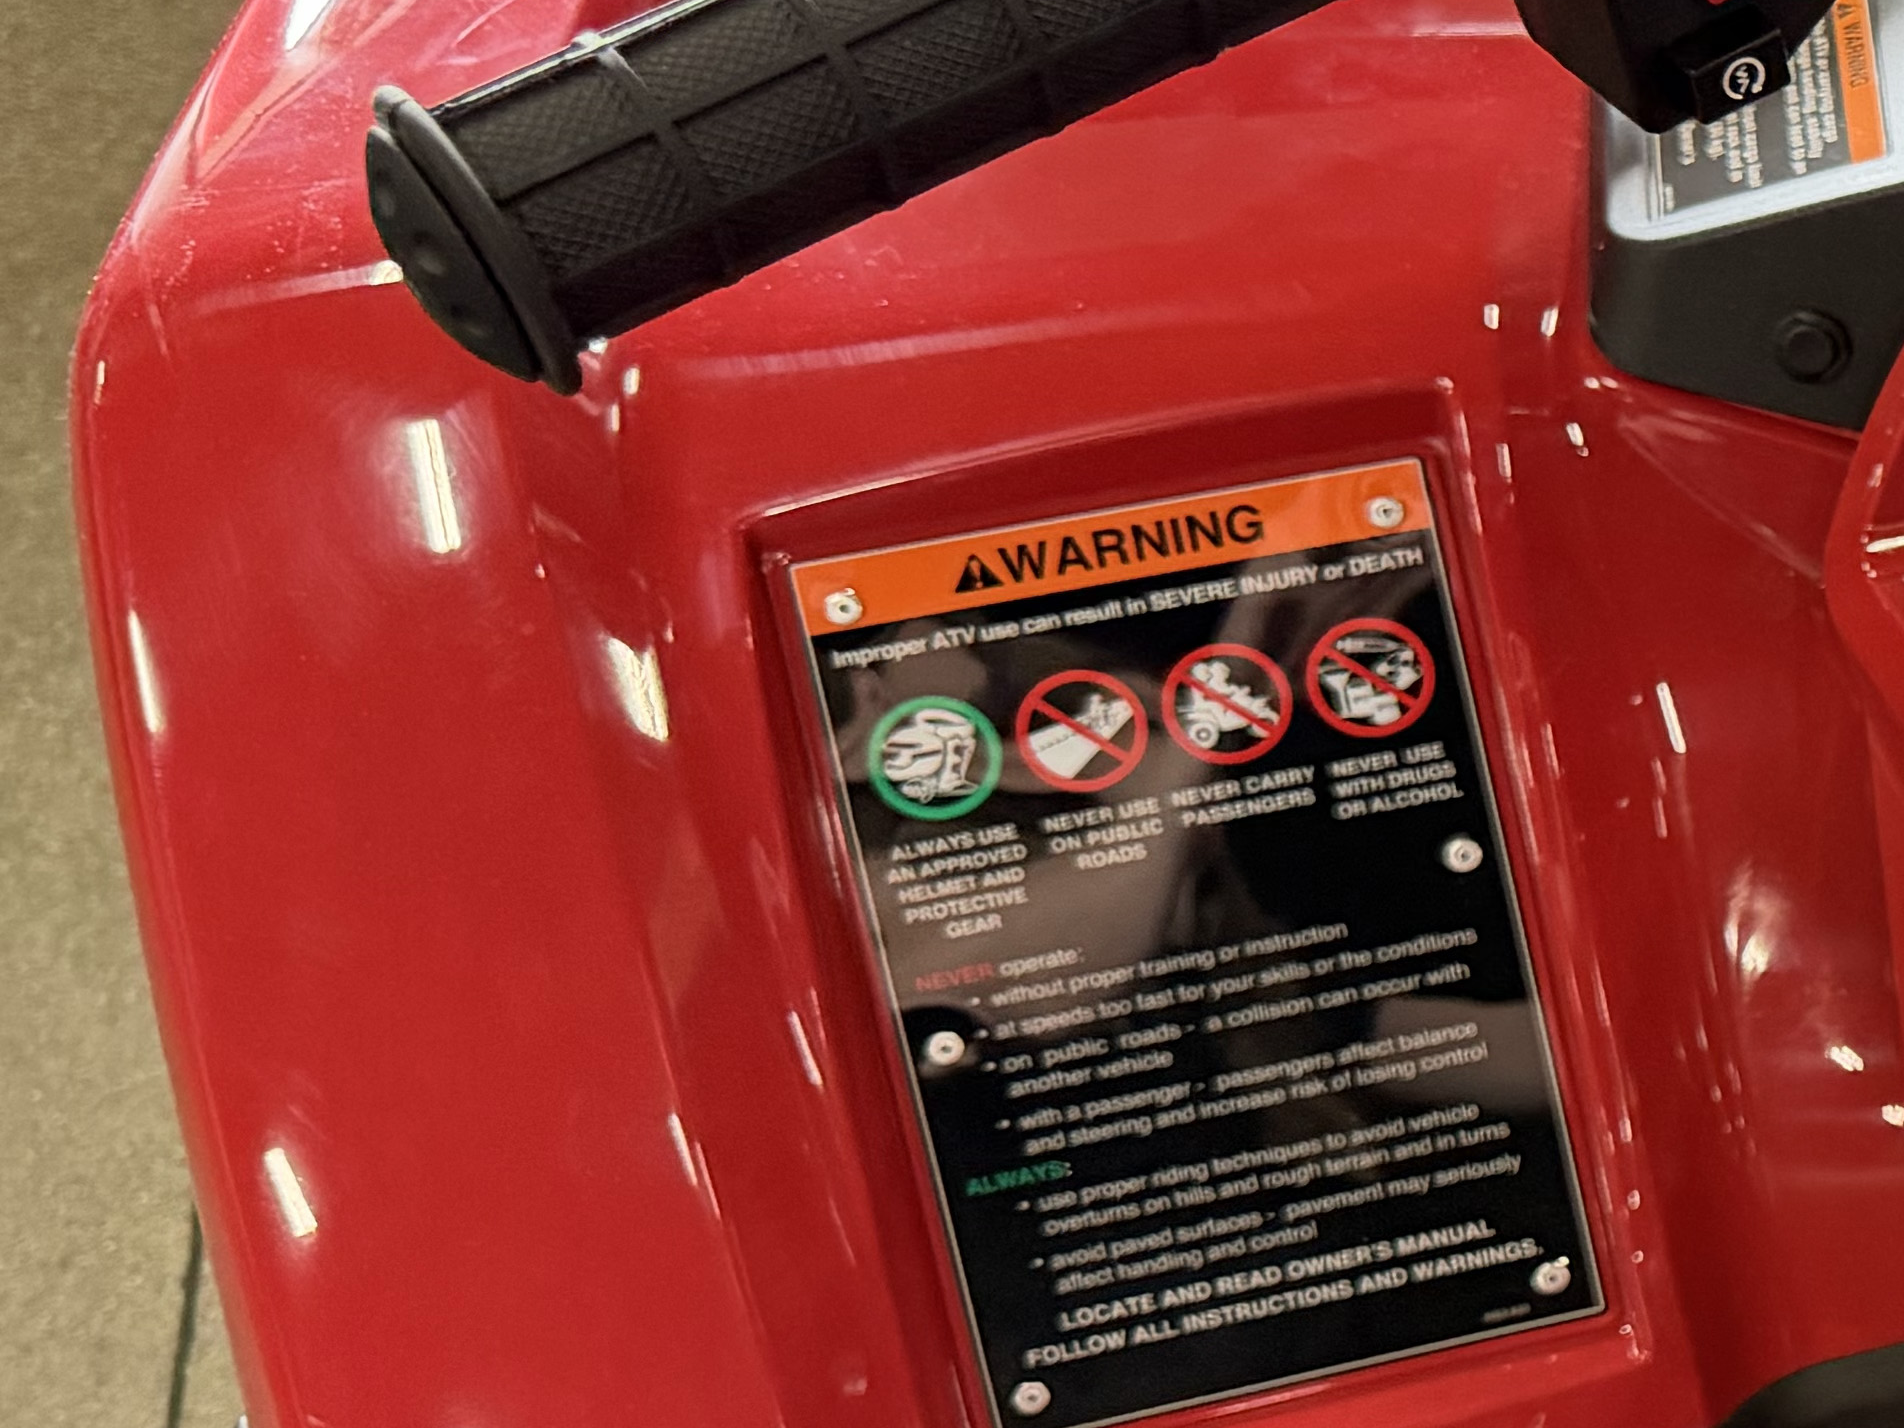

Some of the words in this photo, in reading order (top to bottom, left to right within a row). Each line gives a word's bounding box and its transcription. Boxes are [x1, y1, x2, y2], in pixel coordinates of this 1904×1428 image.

[1844, 22, 1867, 88] WARNING
[998, 503, 1267, 585] WARNING
[830, 633, 930, 672] Improper
[929, 625, 977, 650] ATV
[979, 621, 1020, 642] use
[1021, 614, 1061, 634] can
[1062, 599, 1124, 626] result
[1124, 595, 1147, 615] in
[1148, 578, 1240, 611] SEVERE
[1240, 564, 1320, 595] INJURY
[1323, 562, 1346, 580] or
[1348, 545, 1425, 576] DEATH
[1330, 749, 1398, 778] NEVER
[1403, 740, 1446, 764] USE
[1335, 774, 1387, 799] WITH
[1387, 760, 1456, 789] DRUGS
[1170, 779, 1242, 809] NEVER
[1244, 764, 1317, 795] CARRY
[1181, 786, 1317, 828] PASSENGERS
[1334, 797, 1368, 820] OR
[1368, 779, 1464, 813] ALCOHOL
[1042, 805, 1115, 834] NEVER
[1117, 796, 1161, 820] USE
[1049, 832, 1082, 854] ON
[1085, 817, 1165, 847] PUBLIC
[885, 864, 917, 885] AN
[918, 842, 1028, 879] APPROVED
[889, 830, 976, 863] ALWAYS
[977, 822, 1021, 847] USE
[1075, 841, 1149, 871] ROADS
[896, 874, 978, 905] HELMET
[980, 865, 1027, 888] AND
[903, 885, 1029, 925] PROTECTIVE
[943, 912, 1003, 939] GEAR
[913, 962, 995, 993] NEVER
[997, 944, 1086, 980] operate:
[988, 977, 1066, 1009] without
[1068, 965, 1136, 995] proper
[1138, 948, 1217, 983] training
[1216, 944, 1242, 963] or
[1243, 921, 1349, 958] instruction
[991, 1020, 1017, 1041] at
[1018, 1004, 1097, 1038] speeds
[1098, 996, 1134, 1020] too
[1135, 988, 1176, 1012] fast
[1176, 981, 1207, 1004] for
[1207, 974, 1257, 1001] your
[1256, 960, 1311, 987] skills
[1313, 957, 1339, 976] or
[1338, 948, 1374, 971] the
[1372, 925, 1478, 964] conditions
[1000, 1052, 1035, 1074] on
[1040, 1035, 1111, 1068] public
[1207, 1013, 1223, 1032] a
[1227, 995, 1314, 1028] collision
[1315, 986, 1359, 1010] can
[1360, 973, 1423, 1001] occur
[1425, 960, 1471, 986] with
[1007, 1065, 1093, 1099] another
[1095, 1049, 1175, 1081] vehicle
[1016, 1106, 1063, 1132] with
[1063, 1102, 1083, 1122] a
[1215, 1051, 1336, 1094] passengers
[1336, 1037, 1396, 1065] affect
[1397, 1020, 1479, 1052] balance
[1023, 1131, 1067, 1156] and
[1067, 1113, 1154, 1151] steering
[1151, 1104, 1197, 1129] and
[1198, 1085, 1287, 1120] increase
[1287, 1075, 1328, 1101] risk
[1329, 1071, 1353, 1092] of
[1354, 1058, 1418, 1091] losing
[1418, 1042, 1489, 1073] control
[963, 1157, 1073, 1197] ALWAYS:
[1035, 1189, 1078, 1213] use
[1078, 1174, 1151, 1207] proper
[1150, 1160, 1210, 1192] riding
[1210, 1135, 1324, 1179] techniques
[1324, 1131, 1348, 1151] to
[1348, 1117, 1406, 1146] avoid
[1407, 1102, 1481, 1133] vehicle
[1041, 1200, 1141, 1237] overturns
[1142, 1193, 1172, 1215] on
[1172, 1183, 1217, 1209] hills
[1216, 1174, 1260, 1199] and
[1262, 1161, 1322, 1192] rough
[1323, 1146, 1391, 1176] terrain
[1391, 1137, 1433, 1161] and
[1434, 1132, 1456, 1152] in
[1457, 1120, 1511, 1147] turns
[1047, 1241, 1108, 1271] avoid
[1107, 1227, 1175, 1260] paved
[1280, 1182, 1386, 1222] pavement
[1387, 1174, 1432, 1201] may
[1429, 1150, 1524, 1192] seriously
[1053, 1265, 1115, 1295] affect
[1115, 1245, 1204, 1286] handling
[1204, 1237, 1247, 1262] and
[1248, 1221, 1319, 1253] control
[1055, 1292, 1158, 1332] LOCATE
[1157, 1279, 1213, 1309] AND
[1212, 1264, 1284, 1297] READ
[1285, 1240, 1394, 1281] OWNER'S
[1022, 1328, 1129, 1370] FOLLOW
[1128, 1317, 1181, 1346] ALL
[1180, 1278, 1355, 1334] INSTRUCTIONS
[1354, 1266, 1409, 1296] AND
